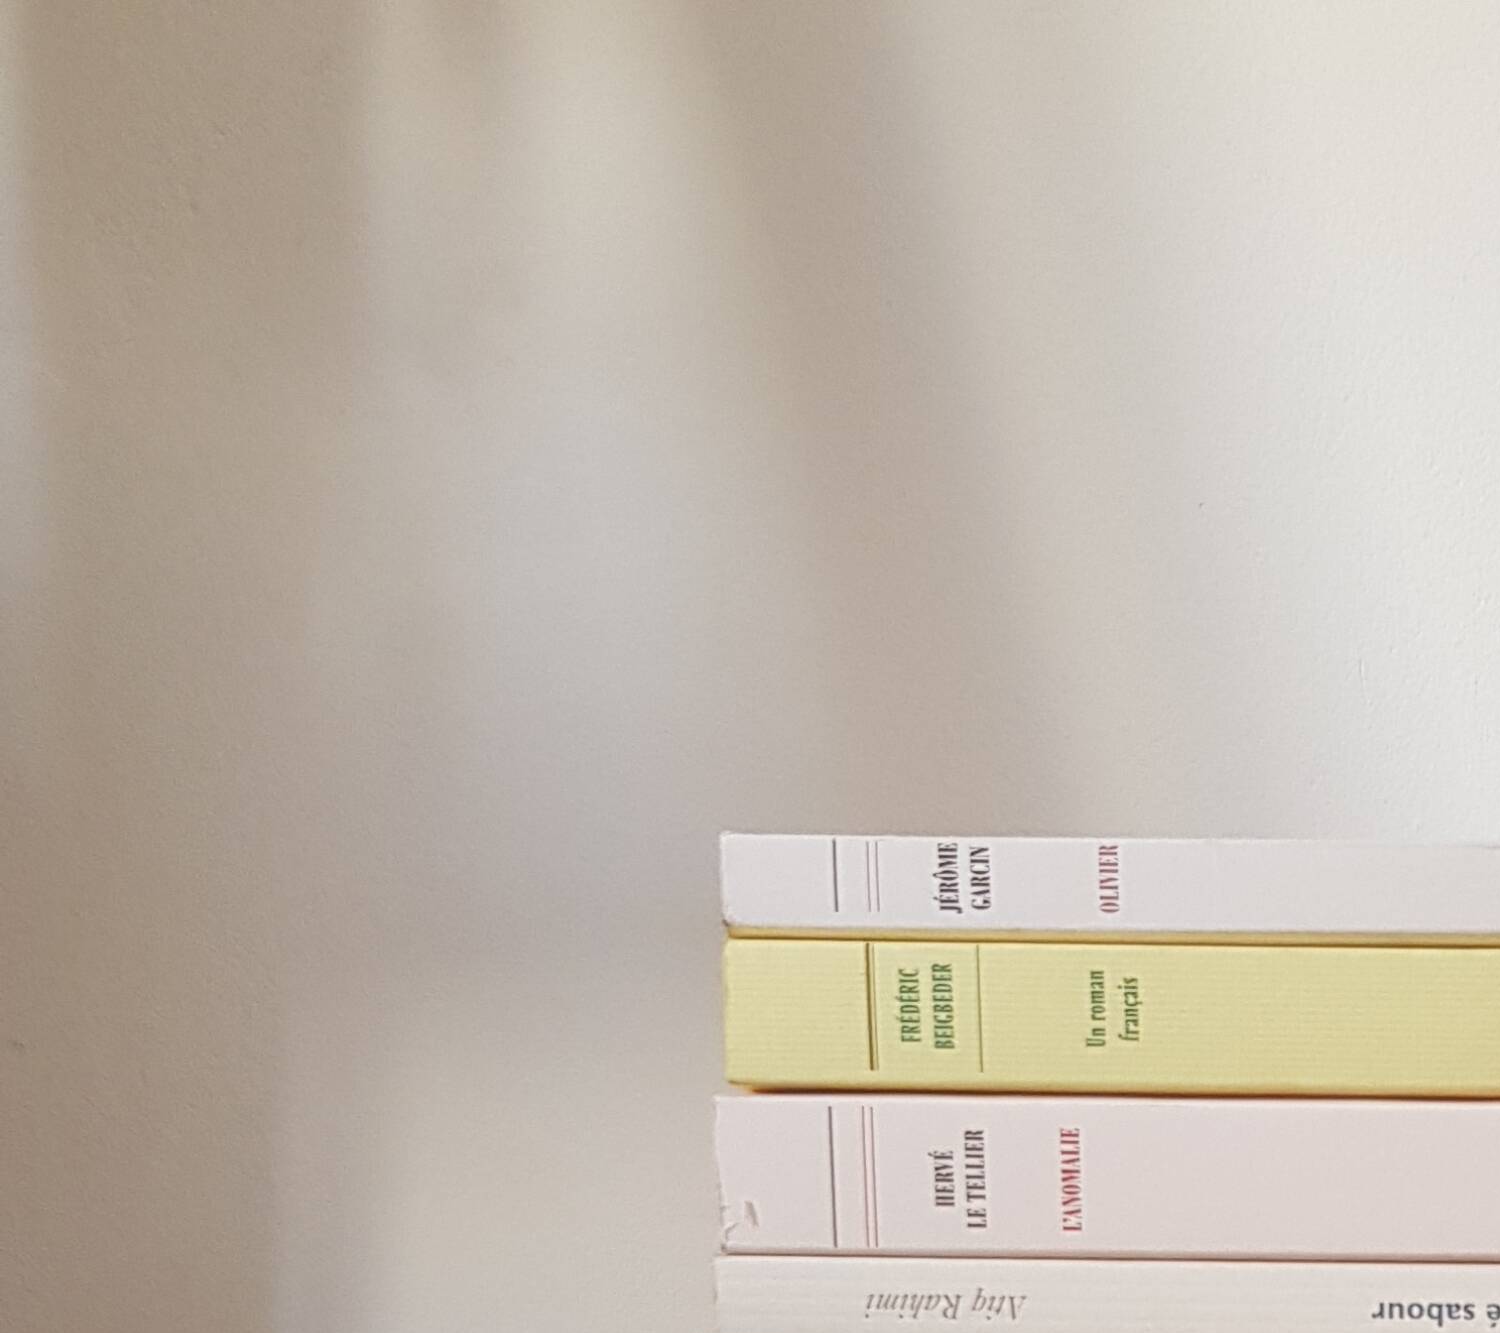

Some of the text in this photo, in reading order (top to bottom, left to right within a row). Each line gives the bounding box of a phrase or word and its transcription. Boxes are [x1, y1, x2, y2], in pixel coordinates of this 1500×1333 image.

[933, 842, 963, 914] JÉRÔME
[970, 845, 992, 911] GARCIN
[1098, 845, 1121, 914] OLIVIER
[897, 967, 922, 1044] FRÉDÉRIC
[933, 962, 955, 1050] BEIGBEDER
[1086, 970, 1106, 1048] Un roman
[1118, 976, 1143, 1043] français
[928, 1149, 956, 1208] HERVÉ
[964, 1129, 988, 1229] LE TELLIER
[1059, 1127, 1083, 1232] L'ANOMALIE
[864, 1287, 1027, 1321] Atiq Rahimi
[1371, 1301, 1476, 1328] sabour
